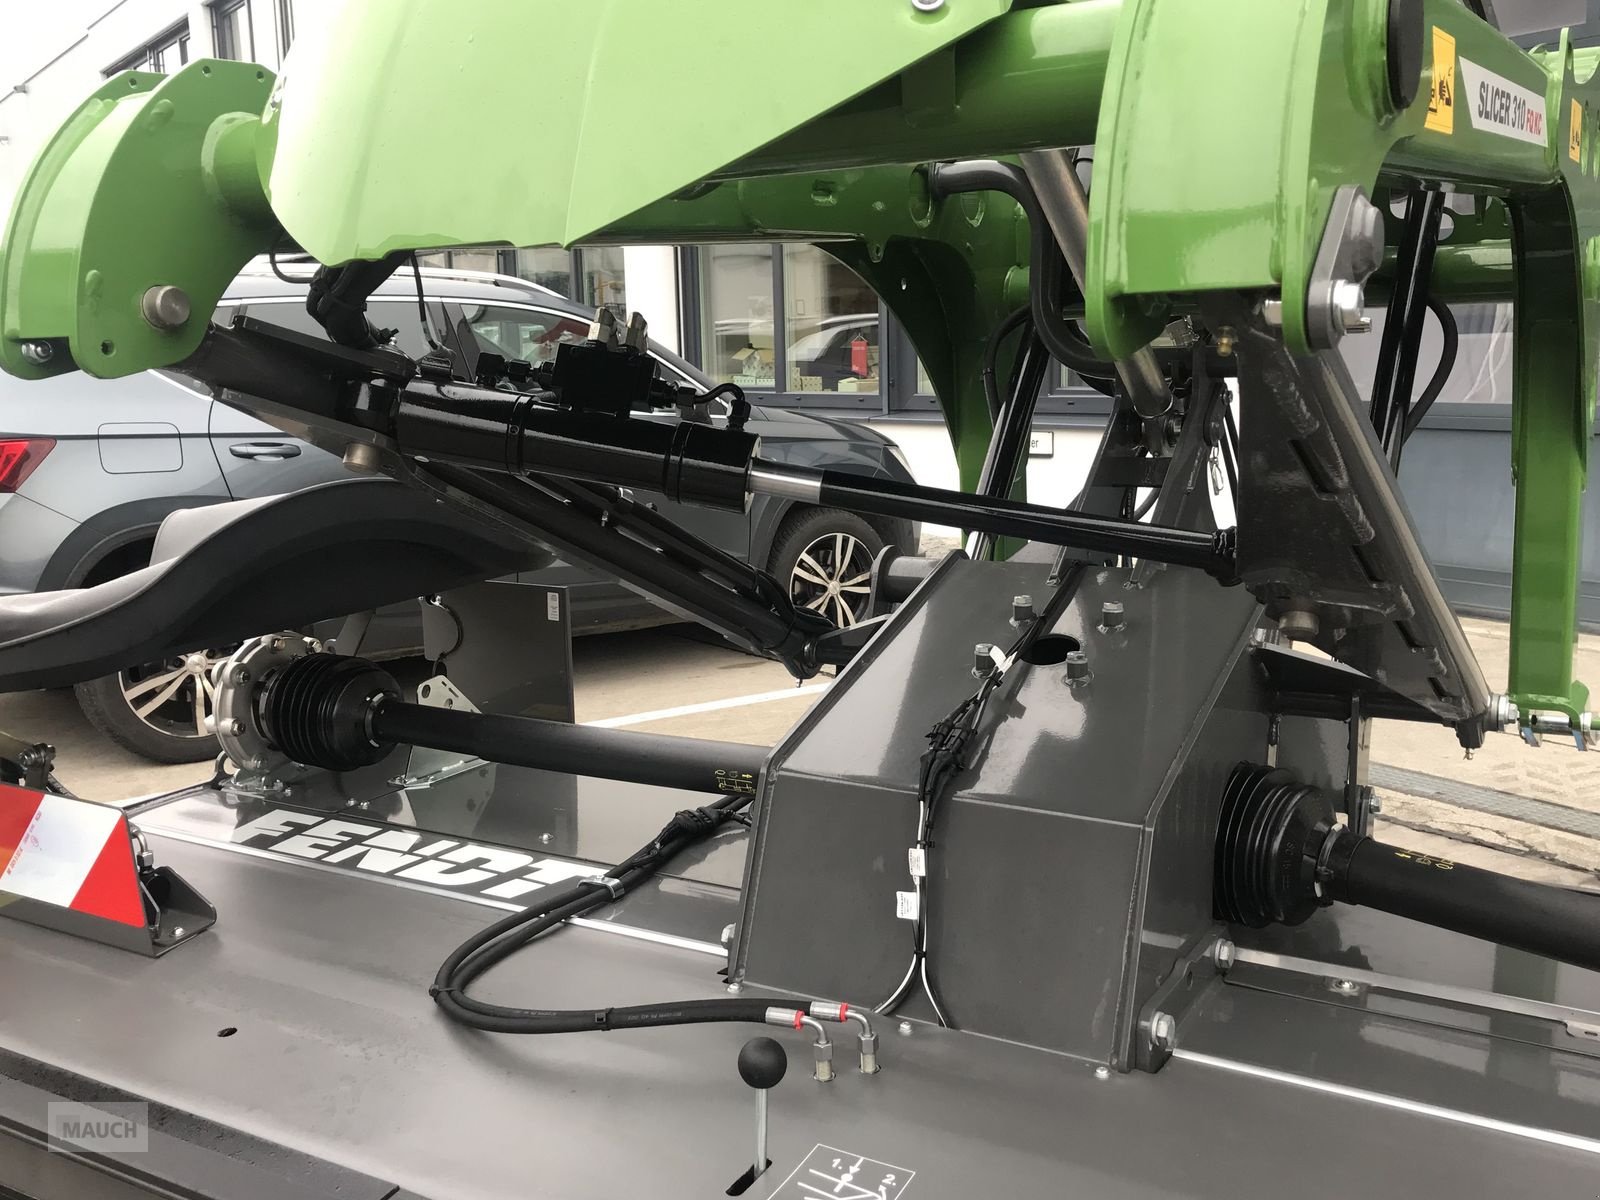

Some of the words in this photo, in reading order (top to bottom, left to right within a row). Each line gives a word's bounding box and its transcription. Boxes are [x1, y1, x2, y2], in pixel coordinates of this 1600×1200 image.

[1478, 81, 1511, 126] SLICER
[1511, 95, 1526, 131] 310
[231, 808, 611, 899] FENDT
